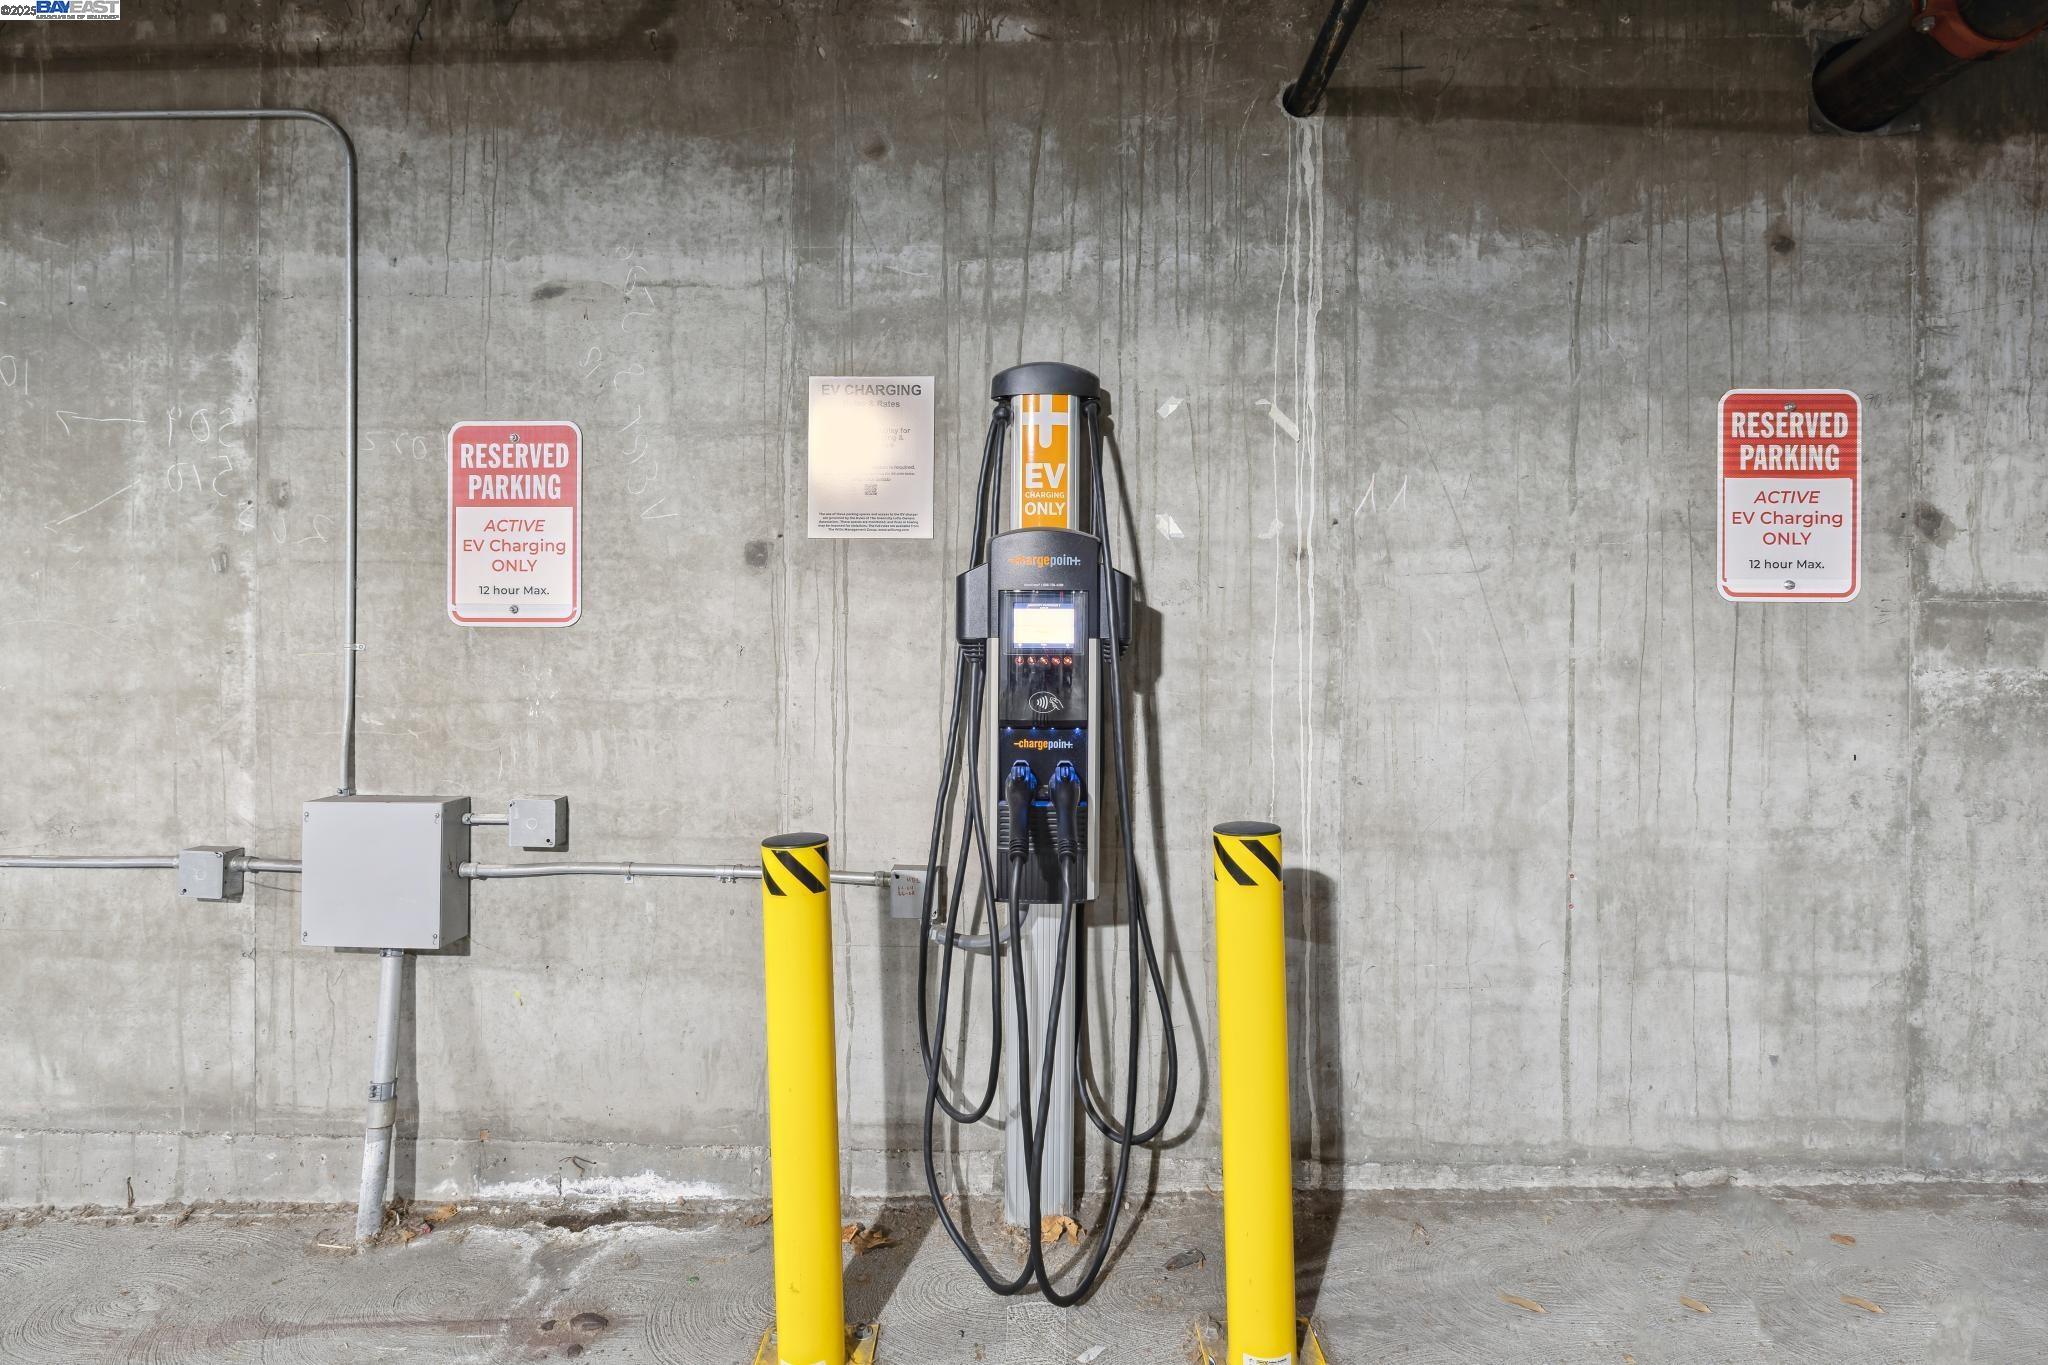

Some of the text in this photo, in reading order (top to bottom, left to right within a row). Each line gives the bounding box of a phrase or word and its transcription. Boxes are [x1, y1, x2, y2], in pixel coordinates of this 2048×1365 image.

[821, 384, 922, 396] EV CHARGING
[876, 400, 901, 408] Rates
[1731, 412, 1849, 439] RESERVED
[460, 443, 570, 469] RESERVED
[1740, 444, 1840, 471] PARKING
[1025, 462, 1065, 489] EV
[468, 474, 561, 500] PARKING
[1025, 491, 1065, 499] CHARGING
[1753, 491, 1820, 504] ACTIVE
[1025, 502, 1066, 516] ONLY
[1732, 511, 1843, 527] EV Charging
[483, 520, 546, 532] ACTIVE
[1762, 532, 1812, 545] ONLY
[463, 539, 566, 555] EV Charging
[491, 560, 538, 572] ONLY
[1749, 559, 1825, 569] 12 hour Max.
[479, 585, 550, 595] 12 hour Max.
